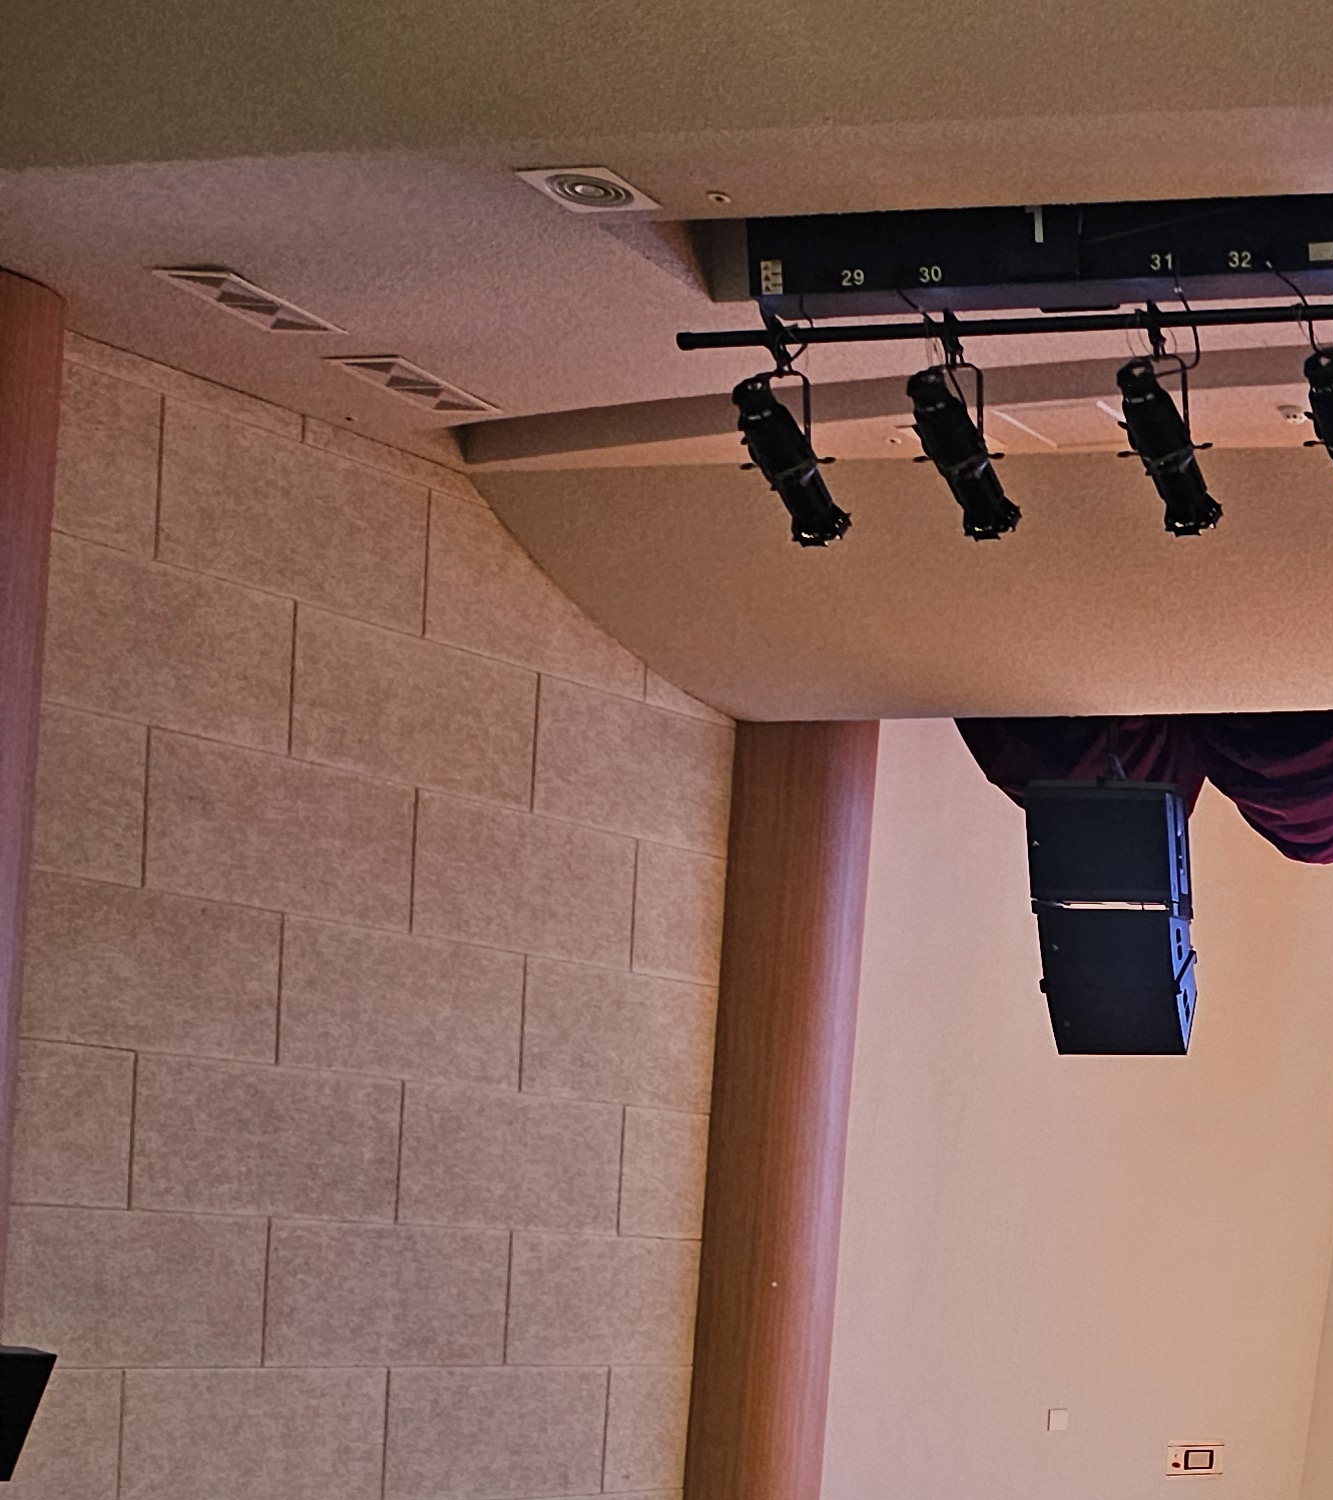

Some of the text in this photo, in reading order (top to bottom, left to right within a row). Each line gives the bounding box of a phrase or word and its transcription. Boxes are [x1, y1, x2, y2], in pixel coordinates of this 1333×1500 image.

[841, 251, 1252, 286] 29 30 31 32
